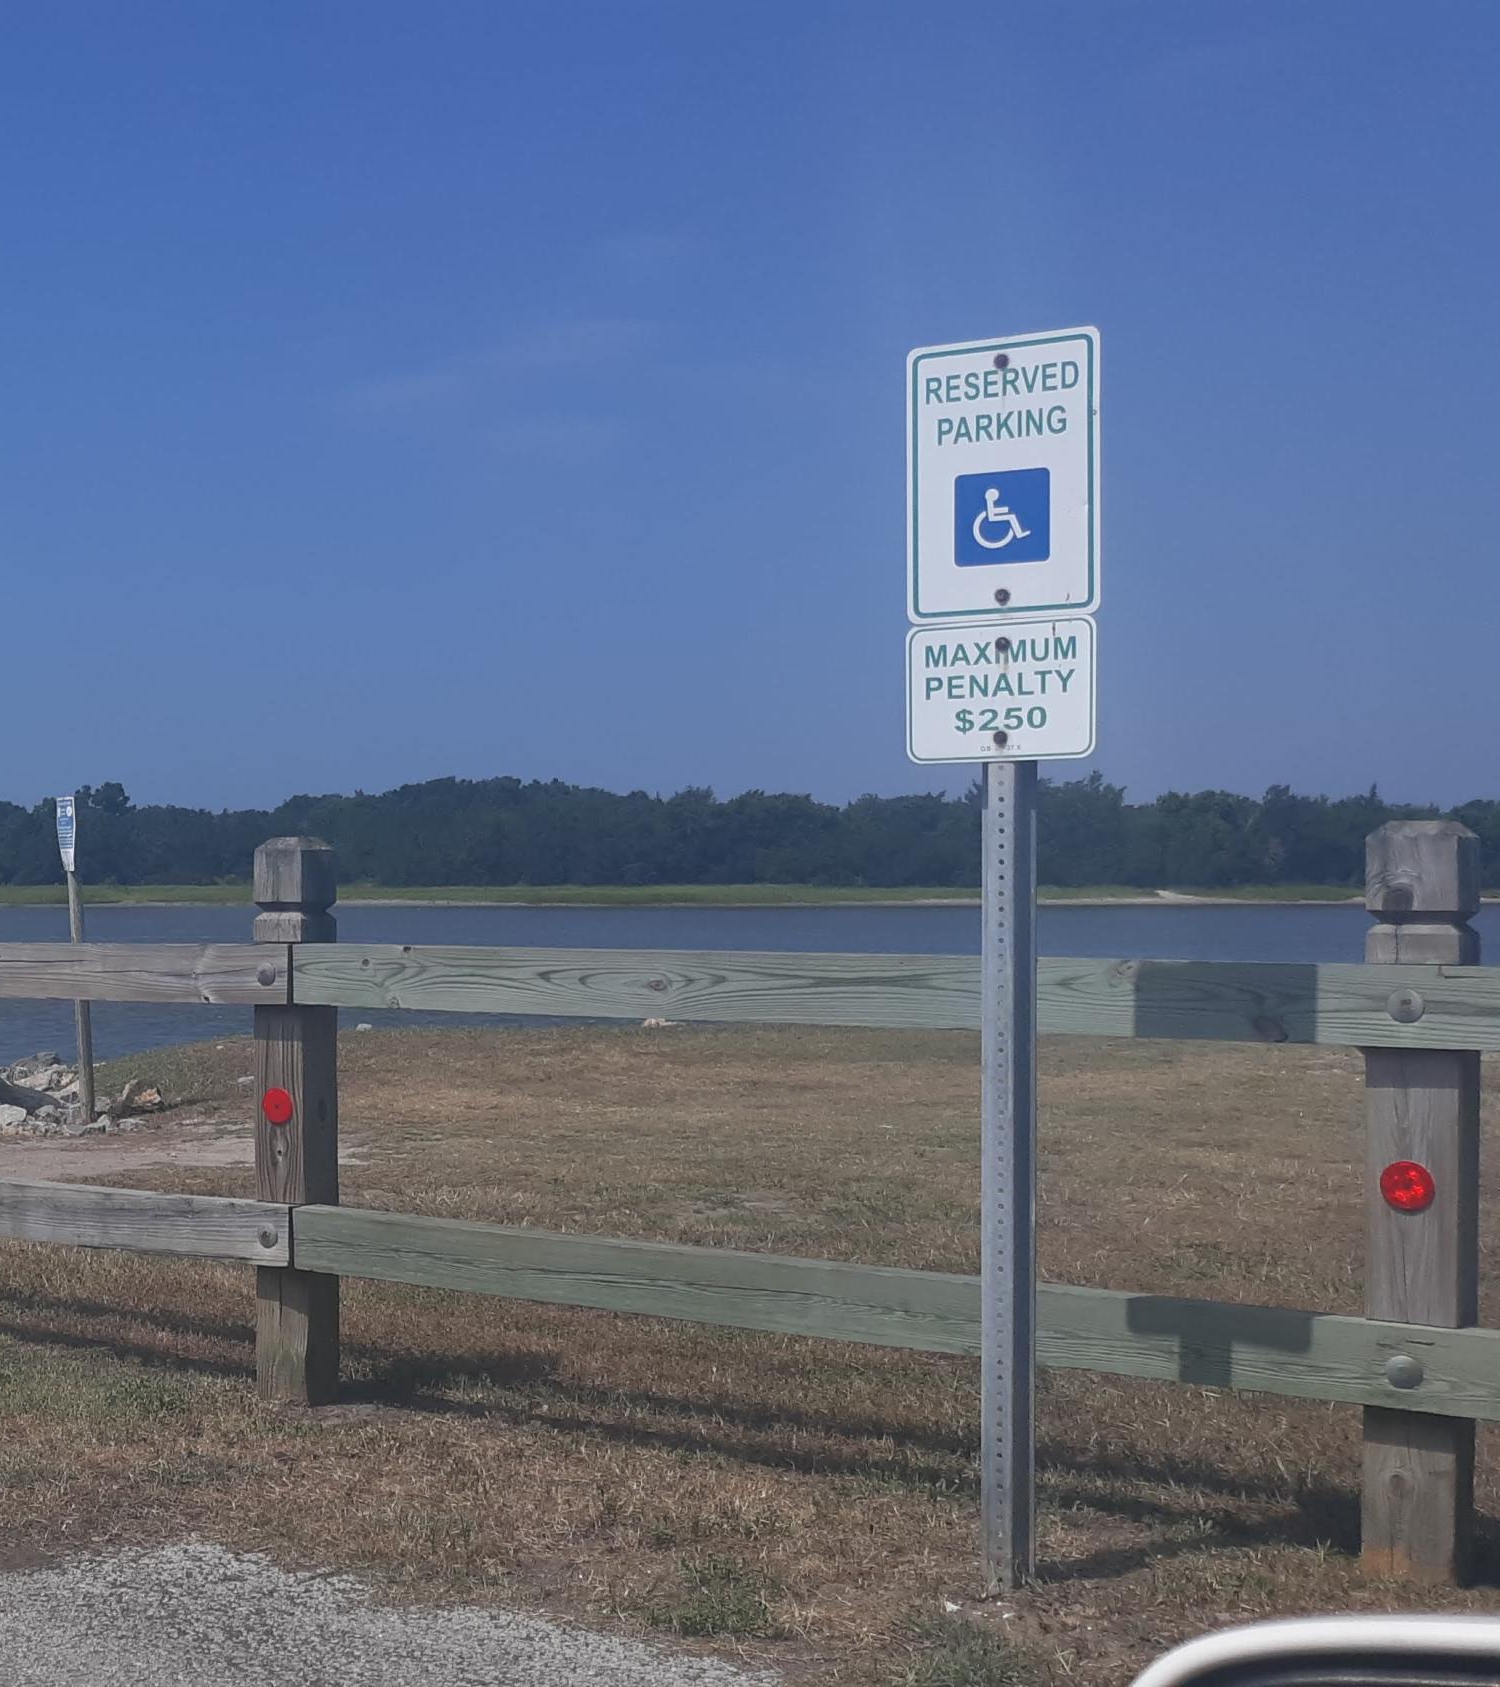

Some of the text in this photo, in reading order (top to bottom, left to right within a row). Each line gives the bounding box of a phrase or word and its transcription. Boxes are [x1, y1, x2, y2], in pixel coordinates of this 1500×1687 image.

[925, 361, 1079, 404] RESERVED
[937, 405, 1067, 446] PARKING
[925, 637, 1077, 668] MAXIMUM
[925, 669, 1075, 700] PENALTY
[954, 706, 1047, 734] $250
